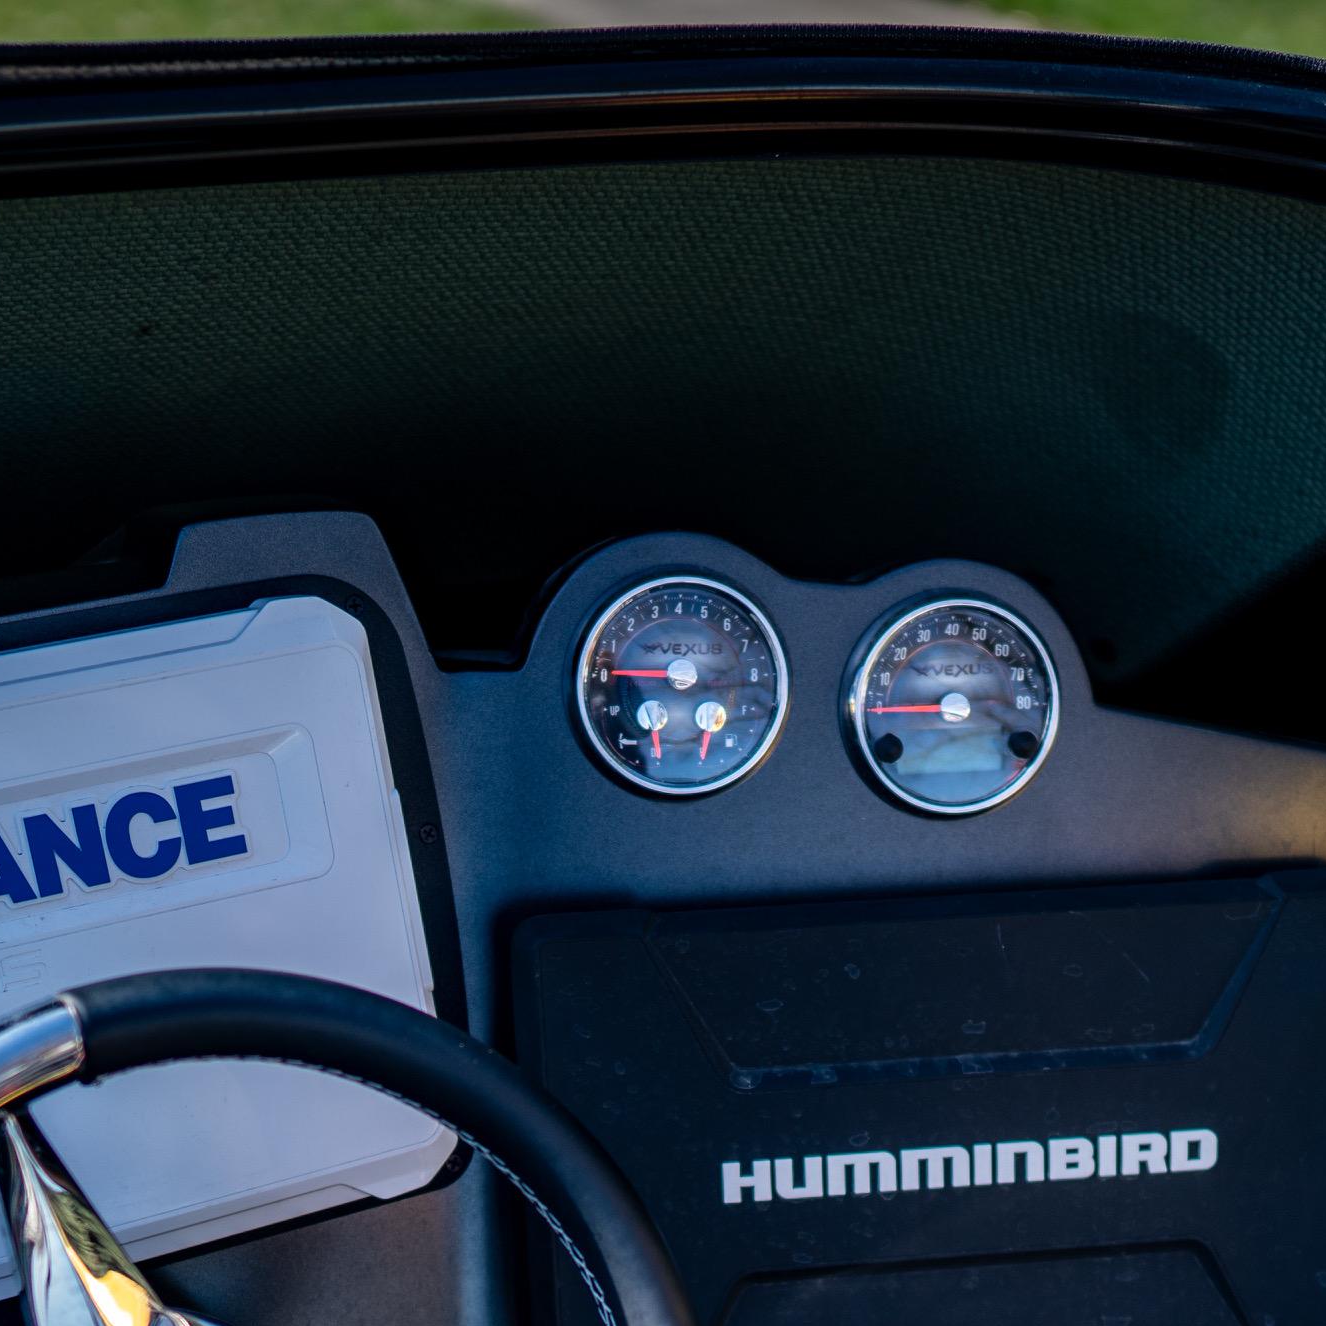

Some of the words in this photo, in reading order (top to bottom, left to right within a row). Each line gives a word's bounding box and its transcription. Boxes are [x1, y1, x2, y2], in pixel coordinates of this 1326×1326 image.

[651, 606, 659, 618] 3
[675, 602, 682, 614] 4
[700, 606, 708, 619] 5
[627, 618, 635, 632] 2
[724, 618, 731, 631] 6
[945, 623, 960, 636] 40
[917, 630, 931, 643] 30
[972, 628, 987, 641] 50
[611, 639, 617, 653] 1
[660, 643, 723, 655] VEXUS
[742, 640, 749, 653] 7
[995, 644, 1010, 657] 60
[893, 647, 907, 661] 20
[600, 668, 608, 682] 0
[751, 668, 759, 682] 8
[934, 663, 994, 676] VEXUS
[1010, 667, 1024, 681] 70
[880, 672, 890, 686] 10
[1016, 696, 1032, 710] 80
[609, 705, 620, 717] UP
[741, 705, 748, 716] F
[722, 1128, 1218, 1204] HUMMINBIRD
